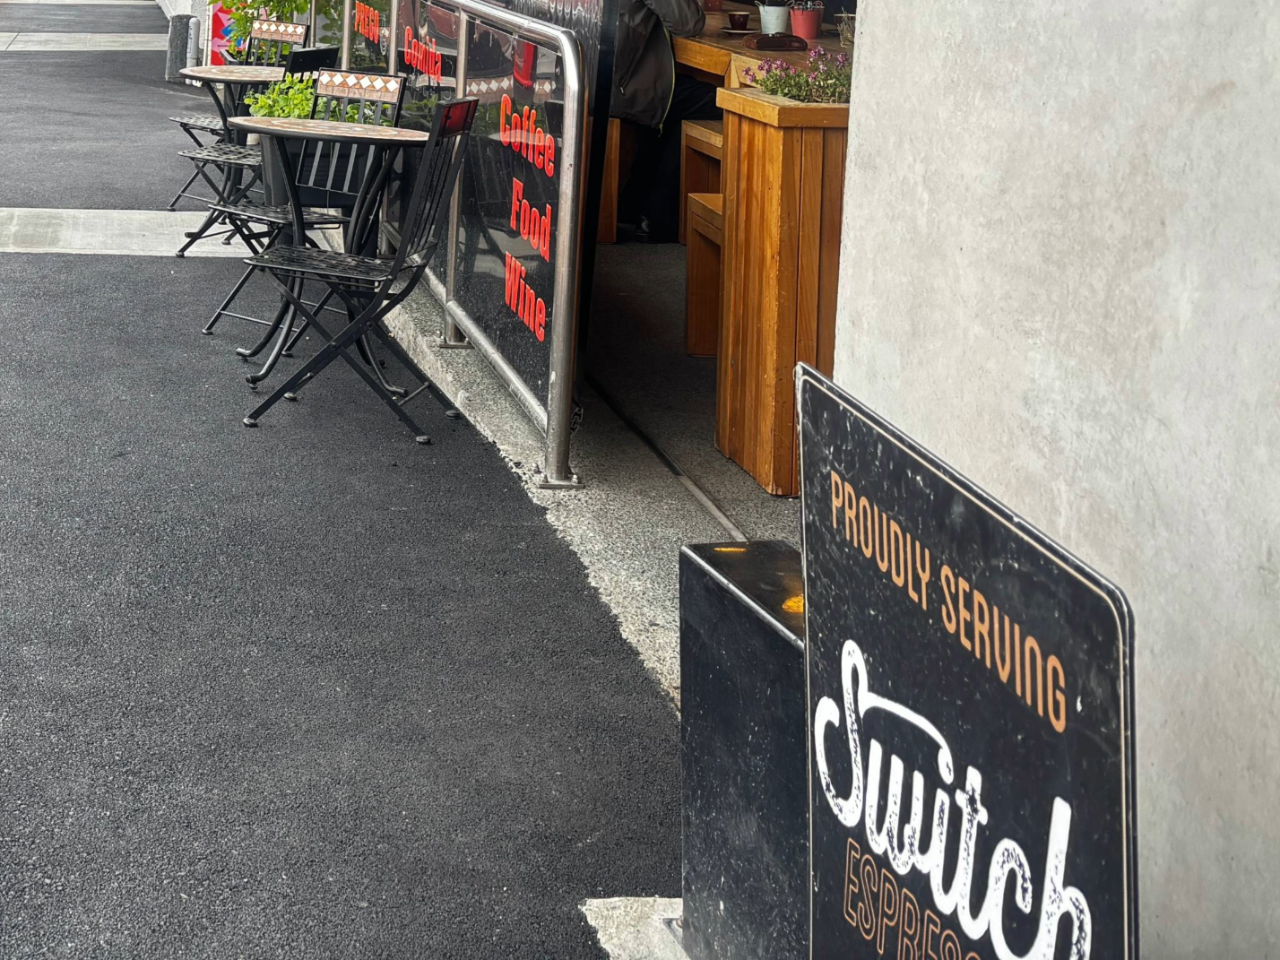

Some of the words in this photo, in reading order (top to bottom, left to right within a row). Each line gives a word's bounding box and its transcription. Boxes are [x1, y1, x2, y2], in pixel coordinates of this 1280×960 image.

[354, 0, 380, 45] PREGO
[404, 26, 442, 83] Comida
[500, 93, 555, 178] Coffee
[510, 177, 552, 262] Food
[504, 251, 546, 342] Wine
[830, 470, 932, 612] PROUDLY
[939, 564, 1067, 734] SERVING
[814, 639, 1092, 960] Switch
